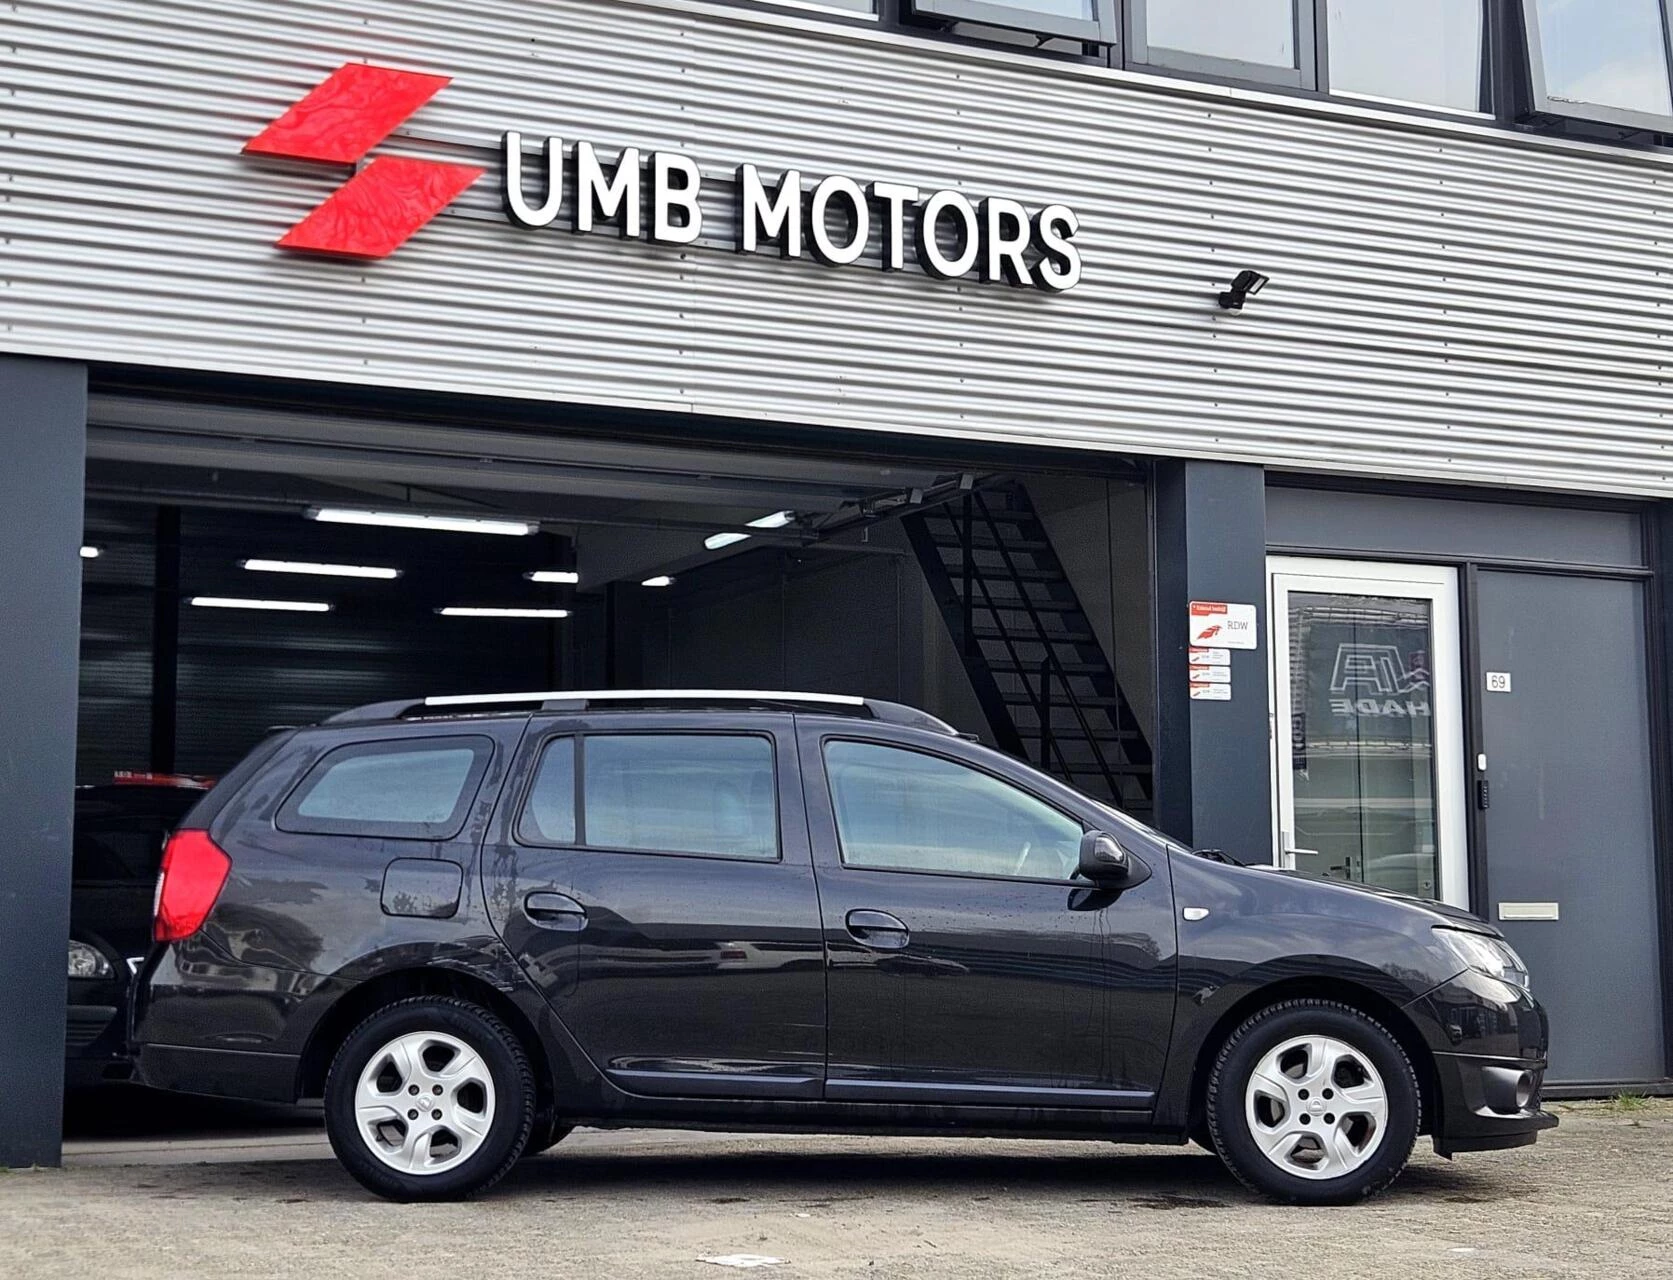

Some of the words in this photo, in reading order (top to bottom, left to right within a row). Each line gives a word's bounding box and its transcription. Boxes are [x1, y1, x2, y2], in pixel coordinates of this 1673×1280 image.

[502, 131, 702, 244] UMB
[737, 163, 1083, 292] MOTORS
[1227, 620, 1249, 631] RDW
[1491, 674, 1506, 689] 69
